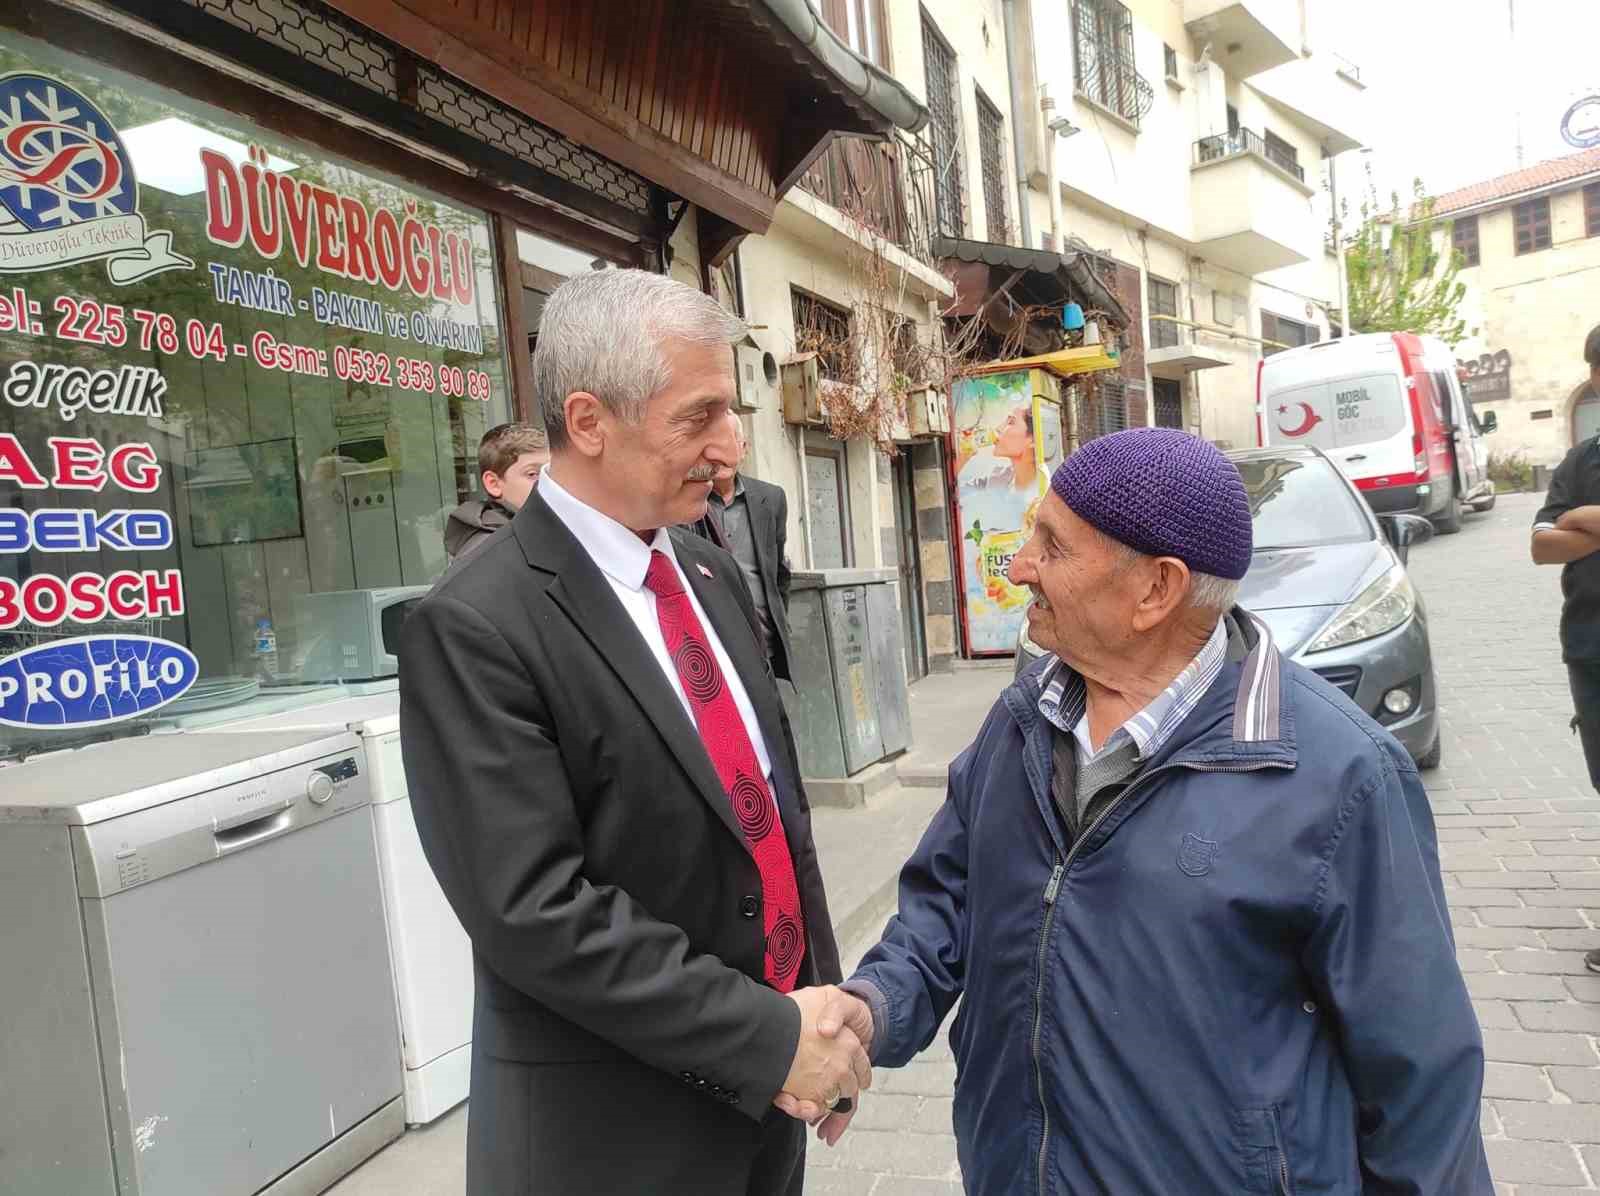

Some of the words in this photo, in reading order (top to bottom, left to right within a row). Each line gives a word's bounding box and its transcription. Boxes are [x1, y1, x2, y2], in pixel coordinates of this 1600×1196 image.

[82, 222, 136, 244] Teknik
[202, 145, 473, 306] DÜVEROĞLU
[208, 264, 295, 316] TAMİR
[312, 288, 384, 334] BAKIM
[386, 312, 408, 339] ve
[411, 314, 483, 354] ONARIM
[0, 289, 43, 335] el:
[55, 296, 127, 346] 225
[133, 312, 178, 354] 78
[187, 320, 227, 361] 04
[253, 332, 328, 376] Gsm:
[334, 346, 392, 386] 0532
[397, 358, 436, 393] 353
[440, 365, 464, 397] 90
[468, 370, 491, 400] 89
[4, 361, 167, 419] arçelik
[0, 433, 161, 491] AEG
[0, 508, 173, 552] BEKO
[987, 553, 1015, 566] FUS
